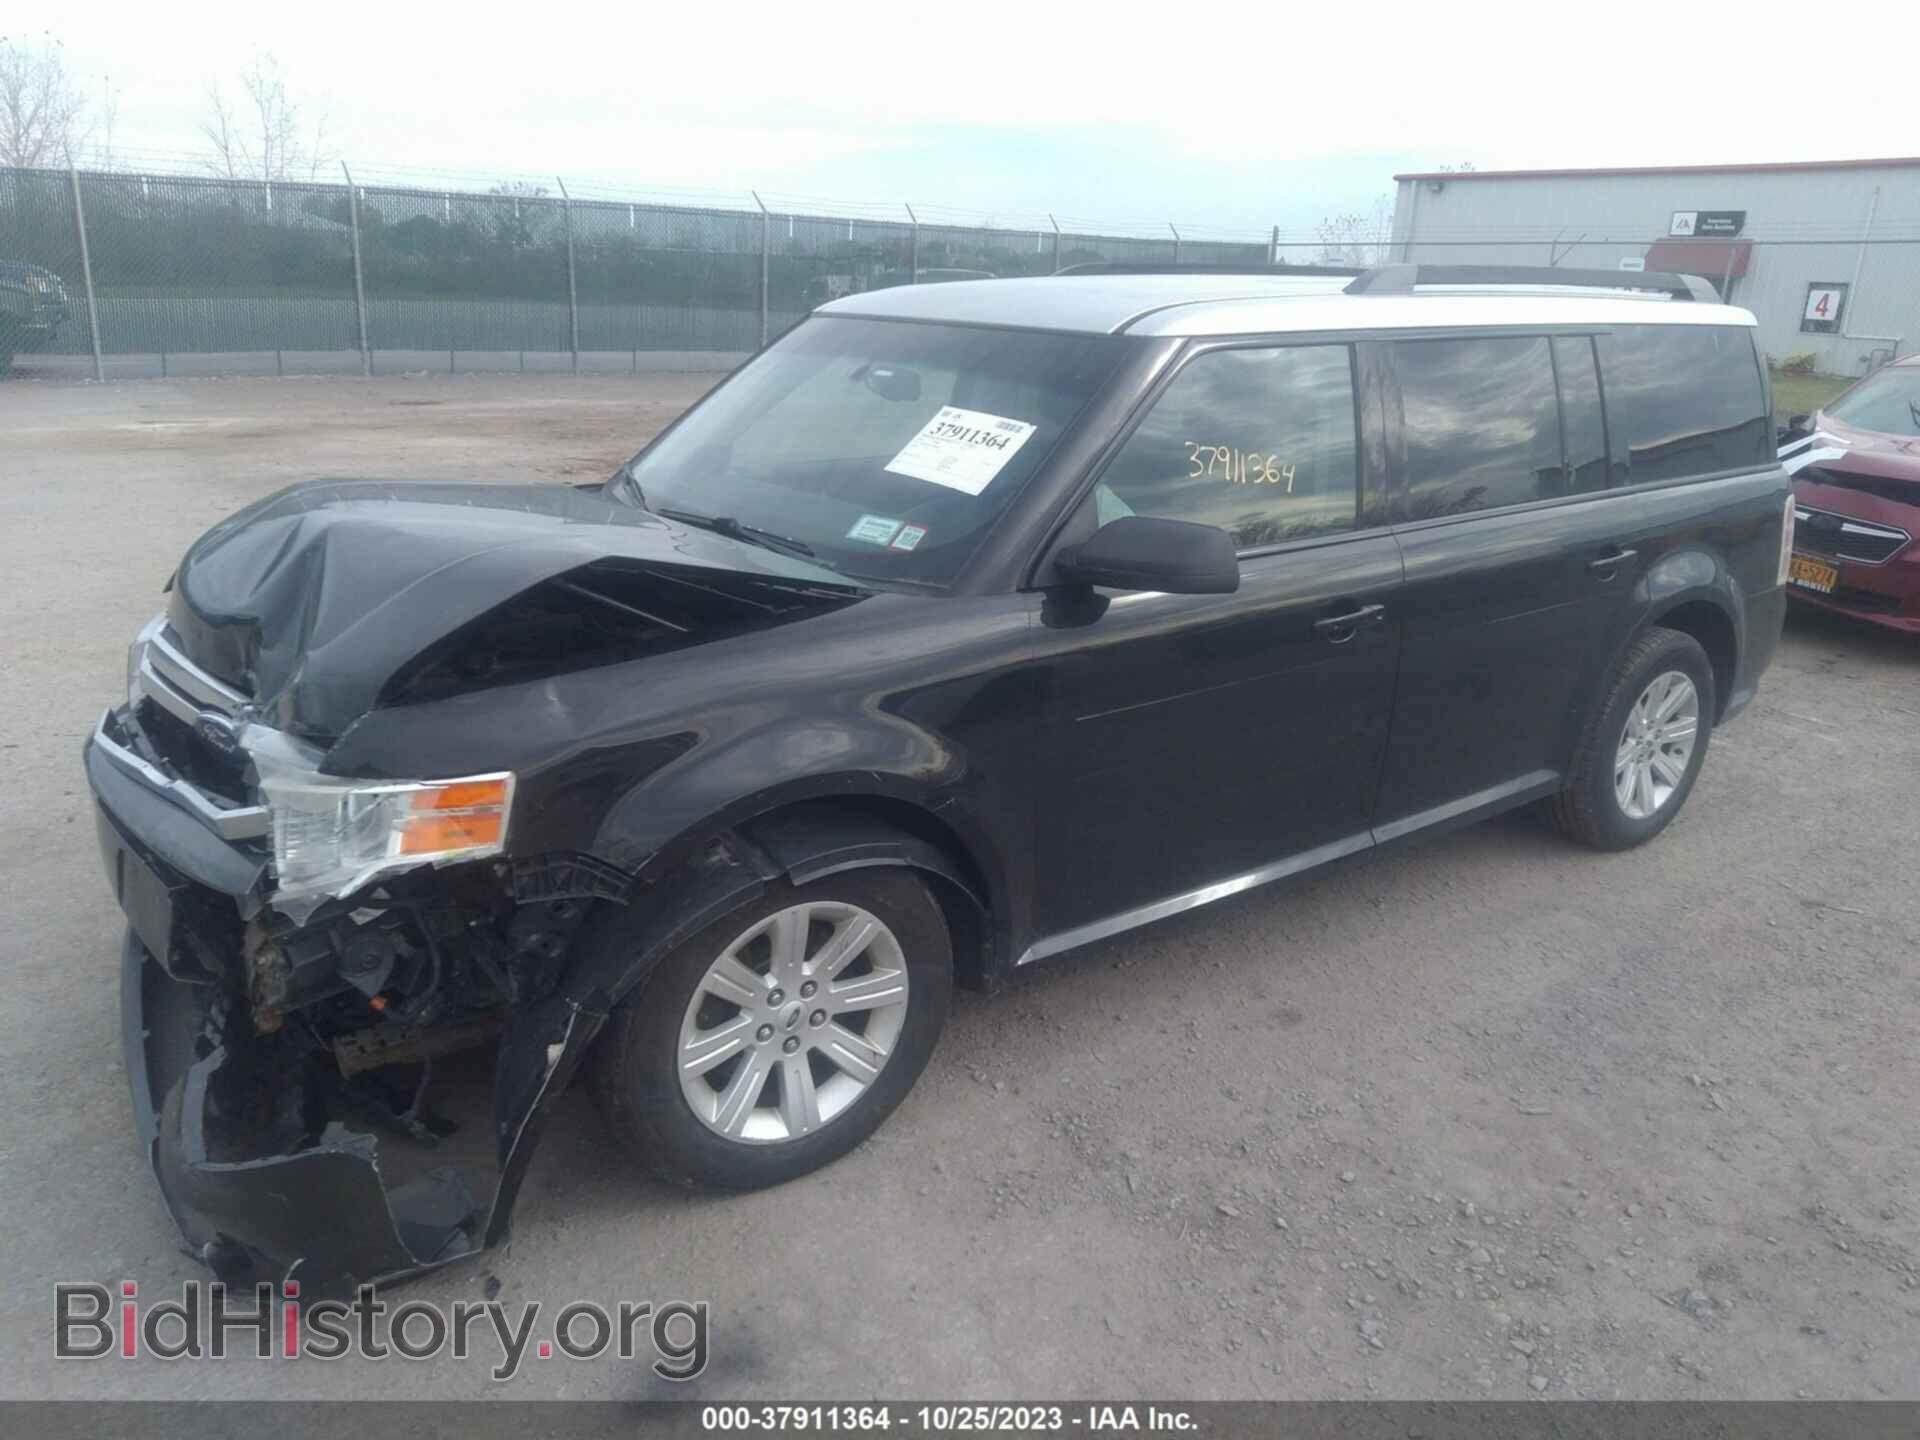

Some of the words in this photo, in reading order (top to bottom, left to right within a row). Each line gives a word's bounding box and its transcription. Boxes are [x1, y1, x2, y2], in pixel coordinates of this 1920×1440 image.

[1815, 293, 1830, 317] 4
[930, 421, 1011, 451] 37911364
[1184, 441, 1296, 494] 37911364
